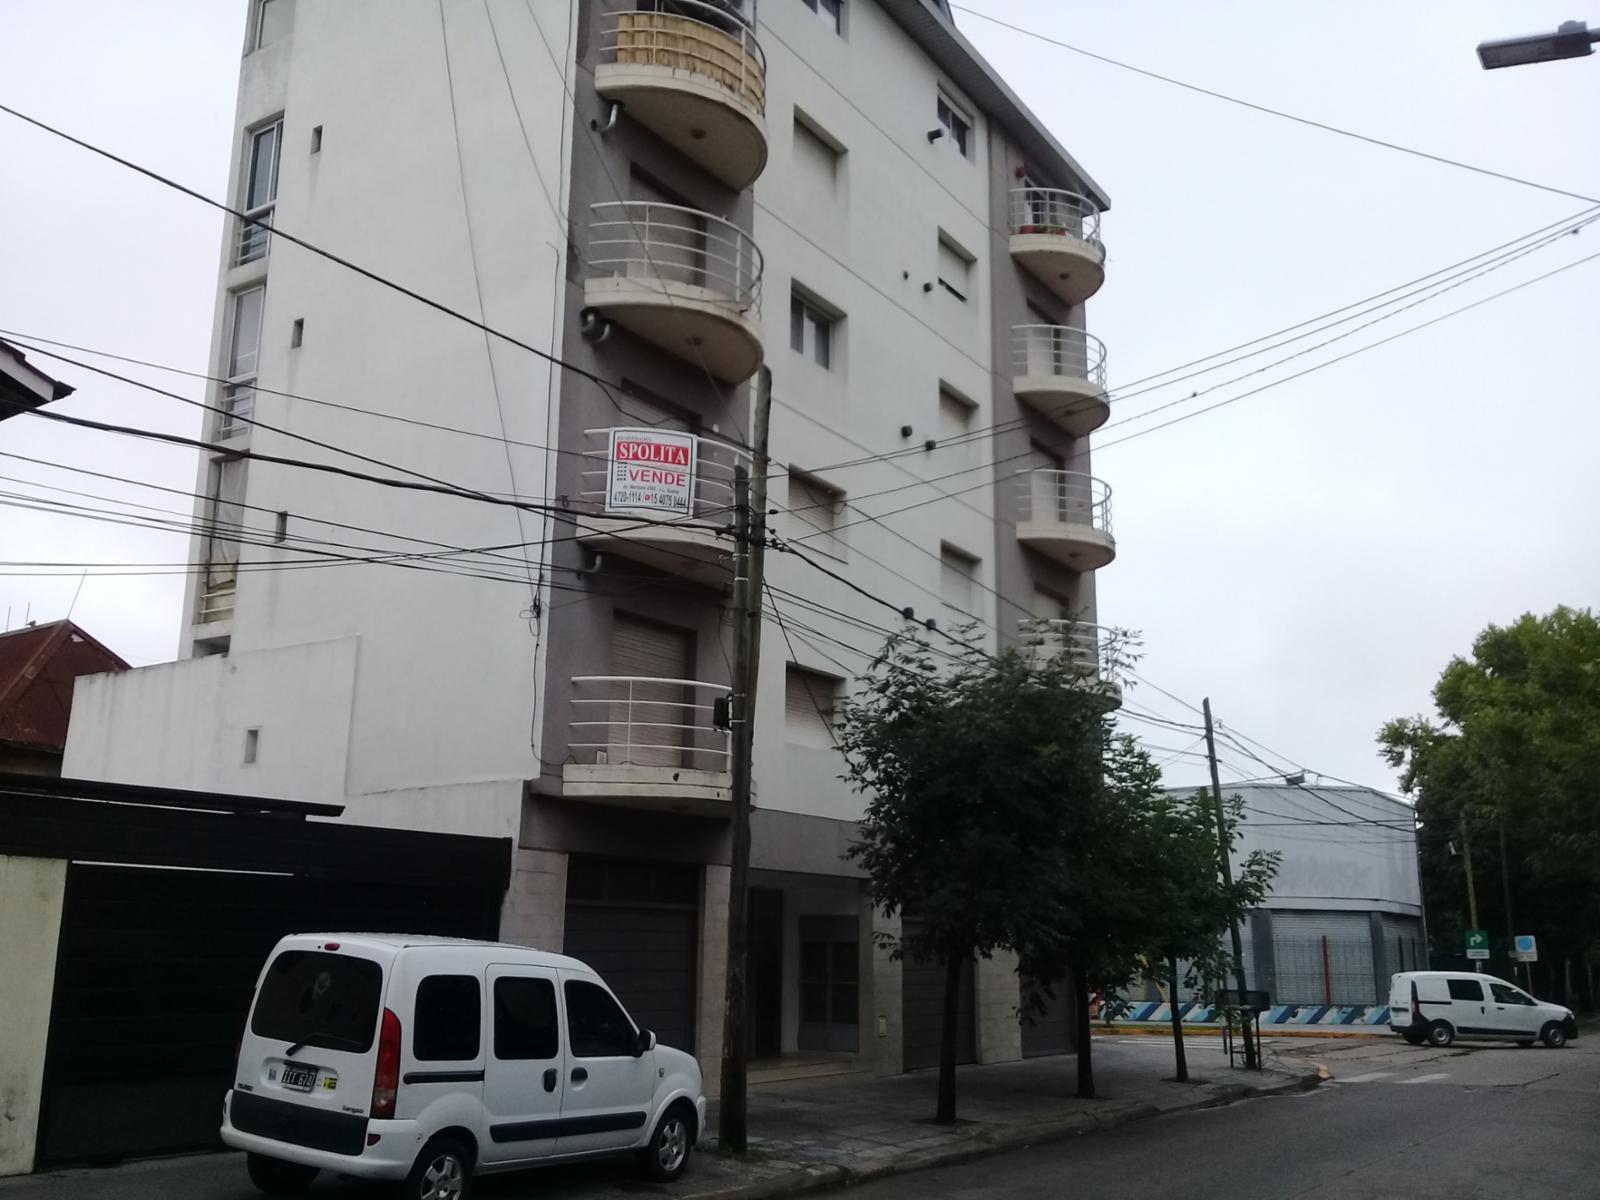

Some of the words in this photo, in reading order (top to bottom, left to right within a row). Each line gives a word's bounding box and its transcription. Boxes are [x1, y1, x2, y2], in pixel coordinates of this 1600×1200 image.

[620, 443, 685, 464] SPOLITA
[629, 469, 686, 487] VENDE
[614, 491, 642, 502] 4720-1114
[651, 493, 658, 504] 15
